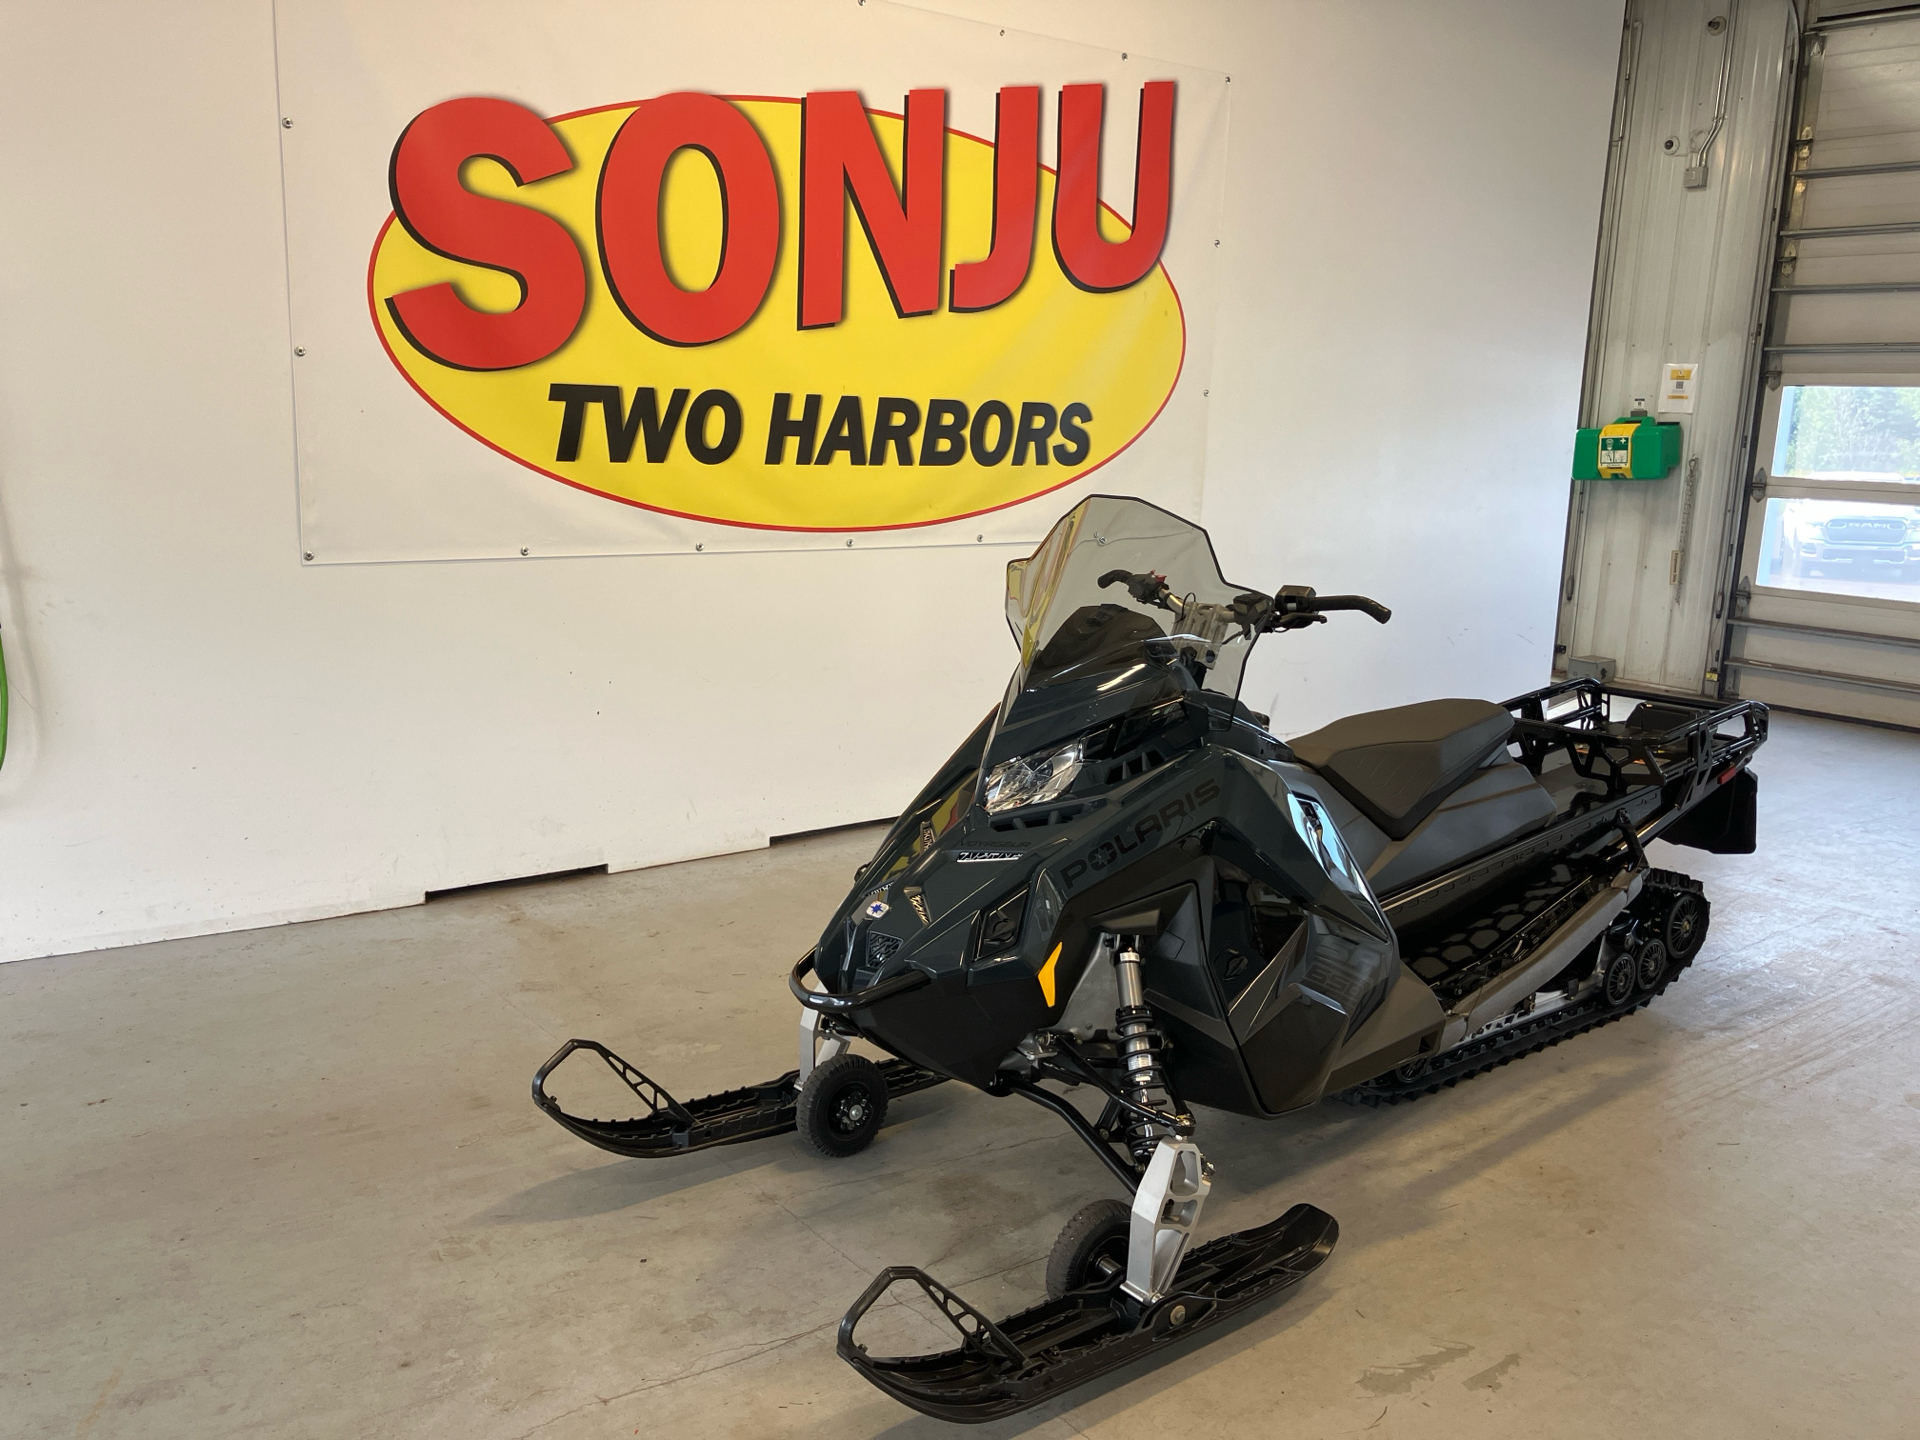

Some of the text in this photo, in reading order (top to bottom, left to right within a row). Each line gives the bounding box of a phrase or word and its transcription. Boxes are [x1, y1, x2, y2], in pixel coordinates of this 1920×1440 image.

[384, 80, 1175, 371] SONJU
[548, 383, 1094, 468] TWO HARBORS
[1059, 777, 1221, 890] POLARIS
